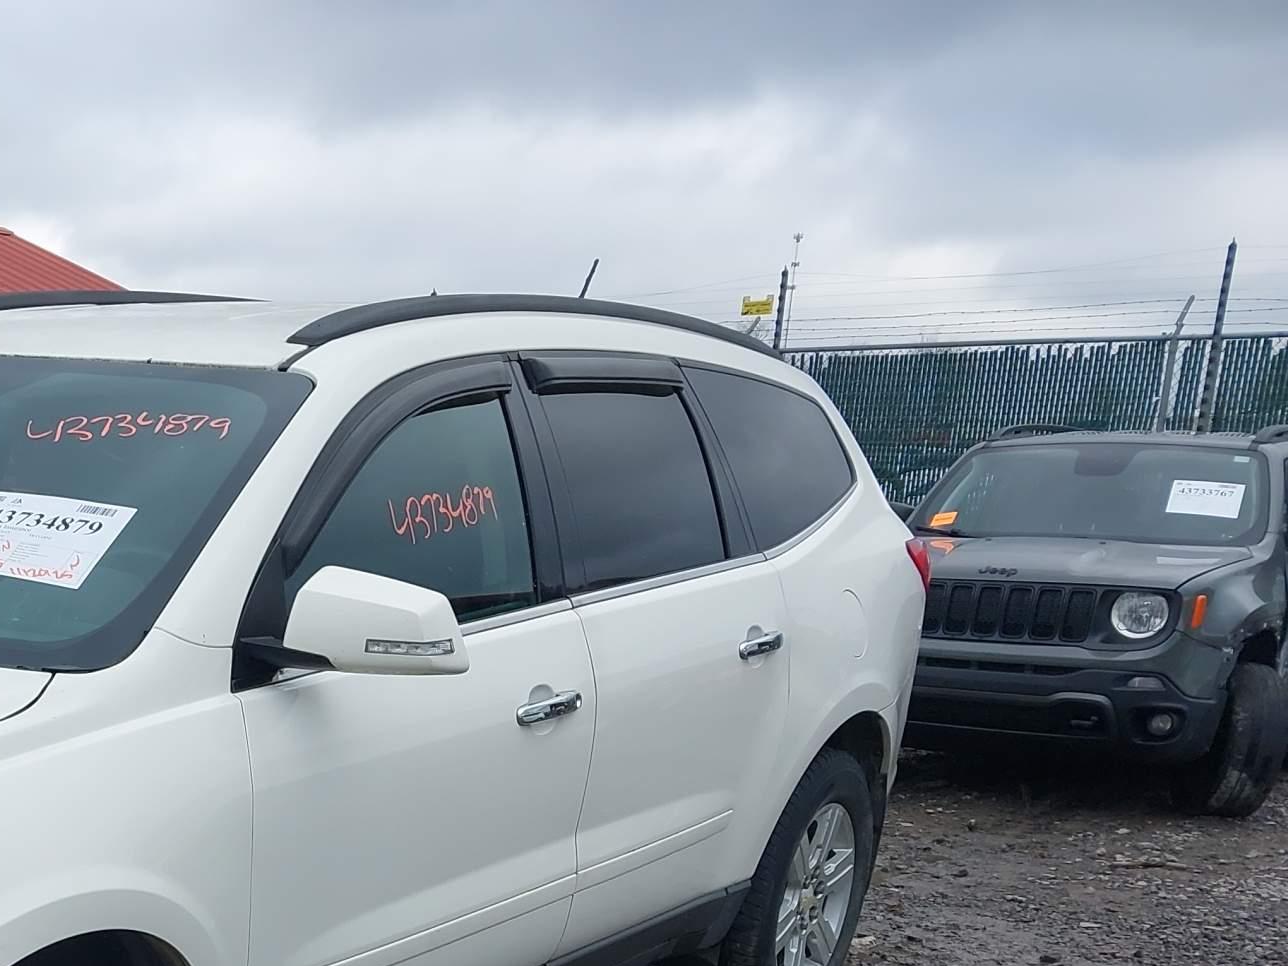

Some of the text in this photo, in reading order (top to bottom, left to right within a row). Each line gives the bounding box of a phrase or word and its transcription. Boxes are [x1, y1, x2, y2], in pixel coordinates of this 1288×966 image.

[26, 411, 232, 442] 43734879
[1178, 487, 1235, 497] 43733767
[387, 484, 498, 545] 43734879
[977, 566, 1018, 577] Jeep
